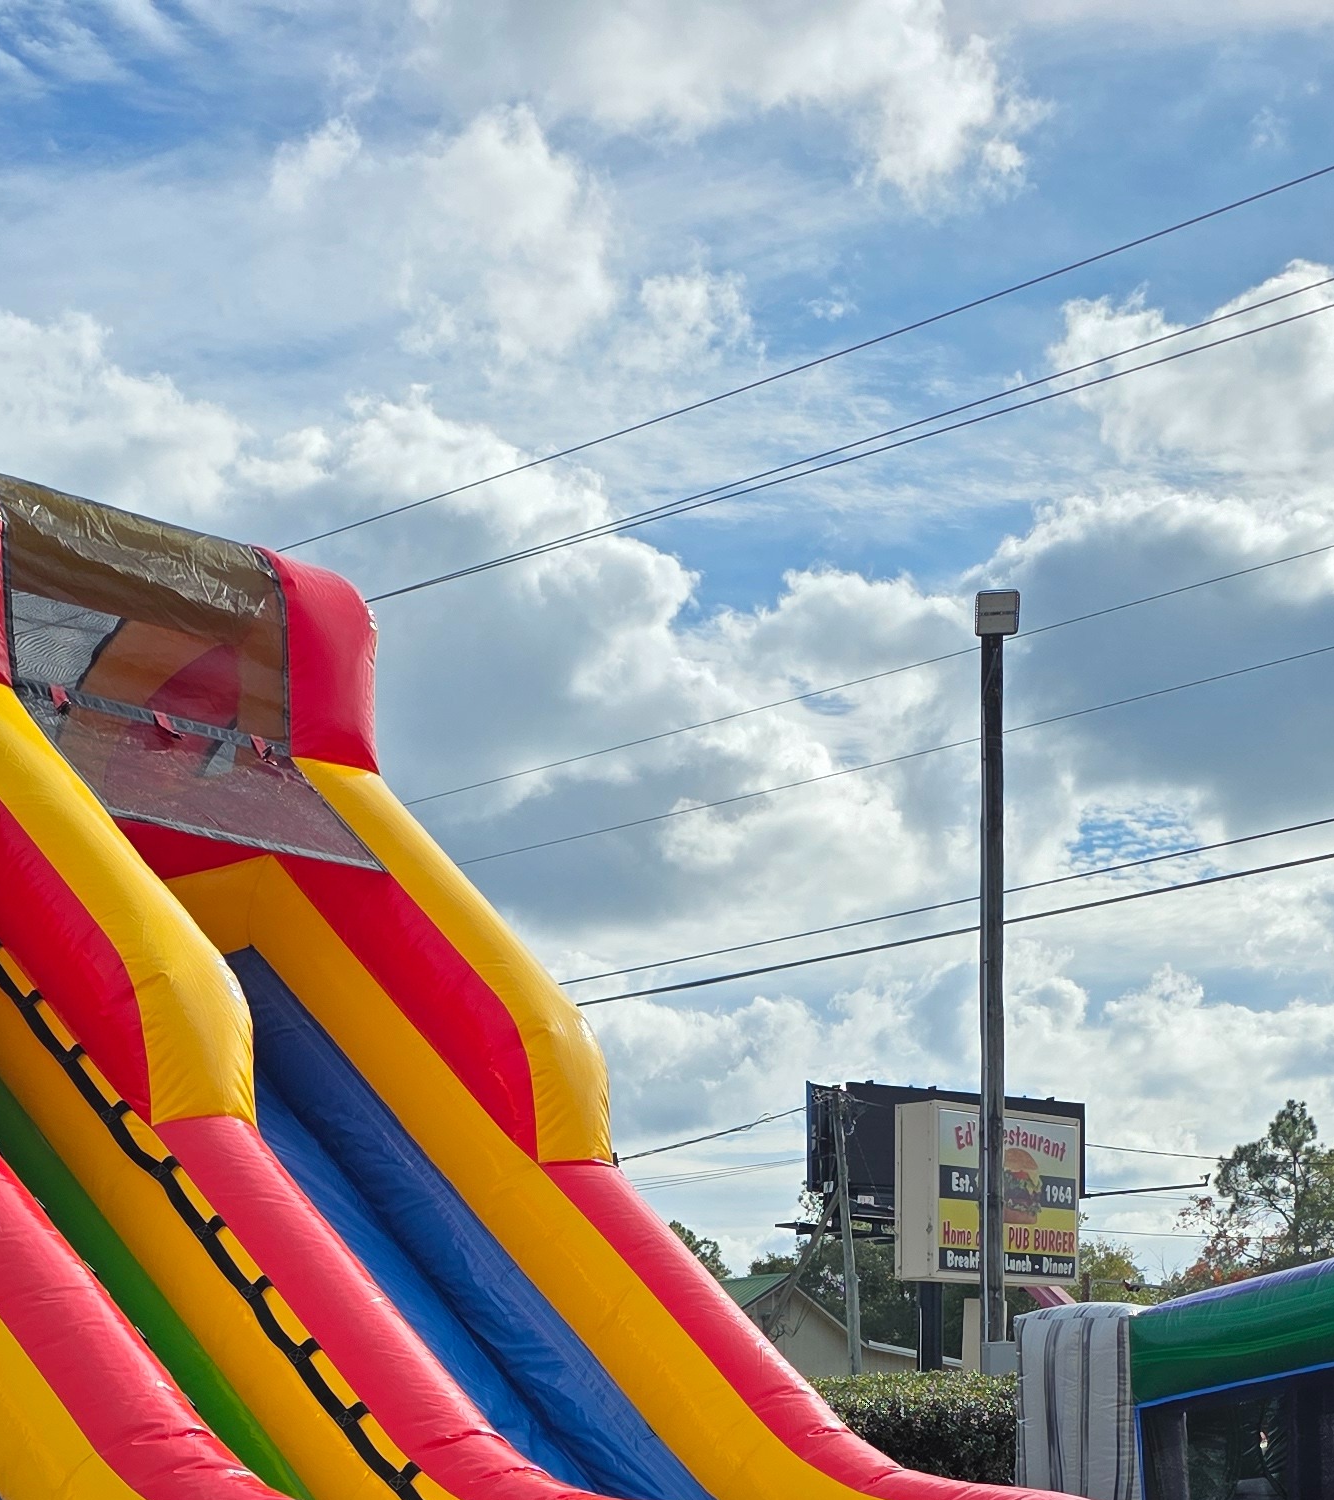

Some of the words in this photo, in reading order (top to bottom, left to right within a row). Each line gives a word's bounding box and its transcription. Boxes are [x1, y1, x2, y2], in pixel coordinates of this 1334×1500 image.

[954, 1120, 976, 1151] Ed'
[1003, 1125, 1066, 1162] estaurant
[951, 1171, 974, 1193] Est.
[1045, 1184, 1073, 1205] 1964
[943, 1220, 972, 1246] Home
[1008, 1226, 1030, 1251] PUB
[1033, 1228, 1075, 1254] BURGER
[946, 1249, 979, 1270] Breakf
[1004, 1253, 1032, 1273] Lunch
[1042, 1256, 1073, 1275] Dinner
